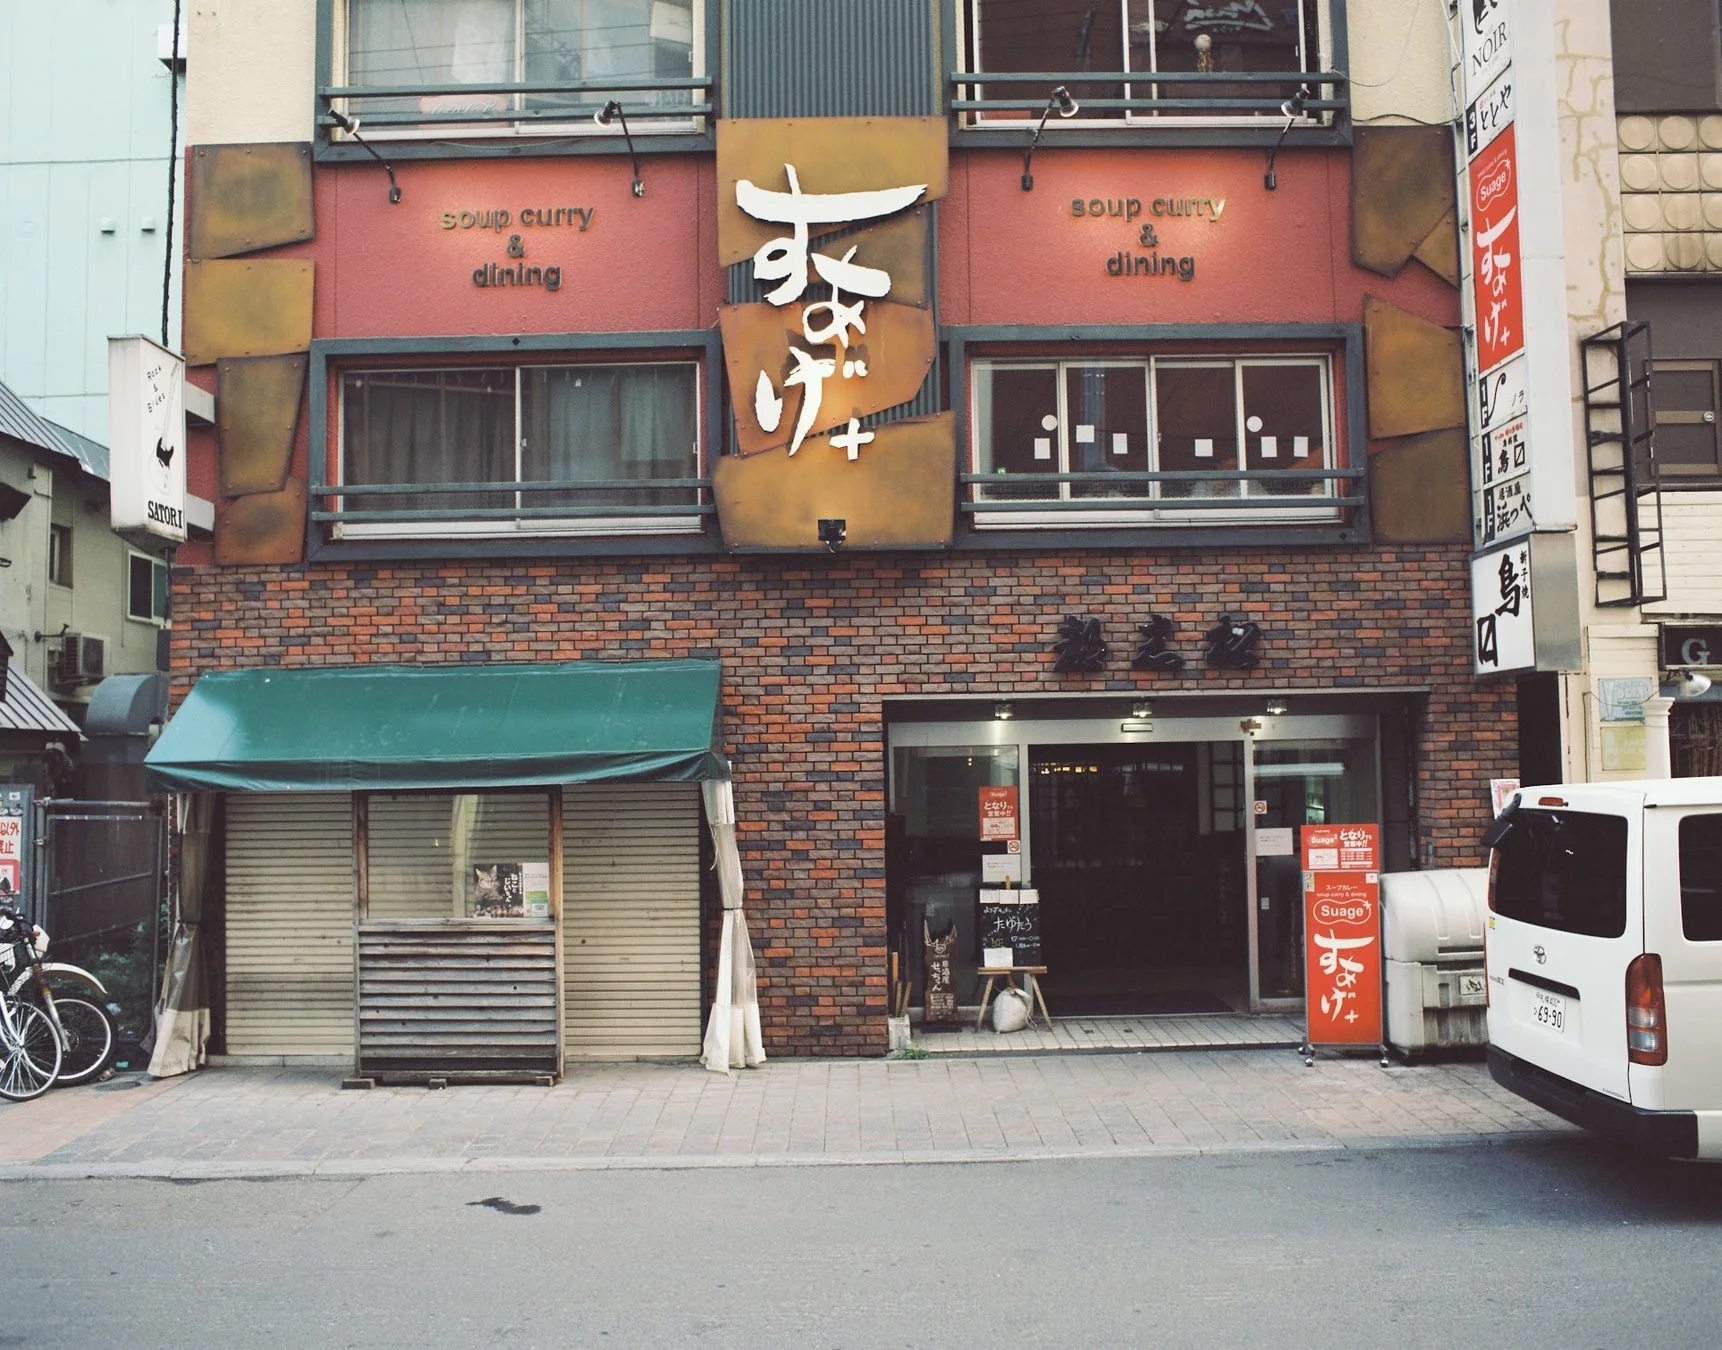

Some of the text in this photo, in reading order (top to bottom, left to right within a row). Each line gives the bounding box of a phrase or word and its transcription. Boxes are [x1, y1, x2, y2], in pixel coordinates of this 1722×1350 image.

[1472, 21, 1507, 76] NOIR
[1480, 171, 1507, 201] Suage
[440, 204, 594, 232] soup curry
[1072, 195, 1225, 222] soup curry
[506, 233, 525, 258] &
[1139, 224, 1158, 247] &
[472, 261, 562, 290] dining
[1106, 250, 1195, 281] dining
[148, 500, 183, 529] SATORI
[1682, 638, 1710, 665] G
[1321, 905, 1363, 919] Suage
[1538, 1005, 1562, 1028] 69-90
